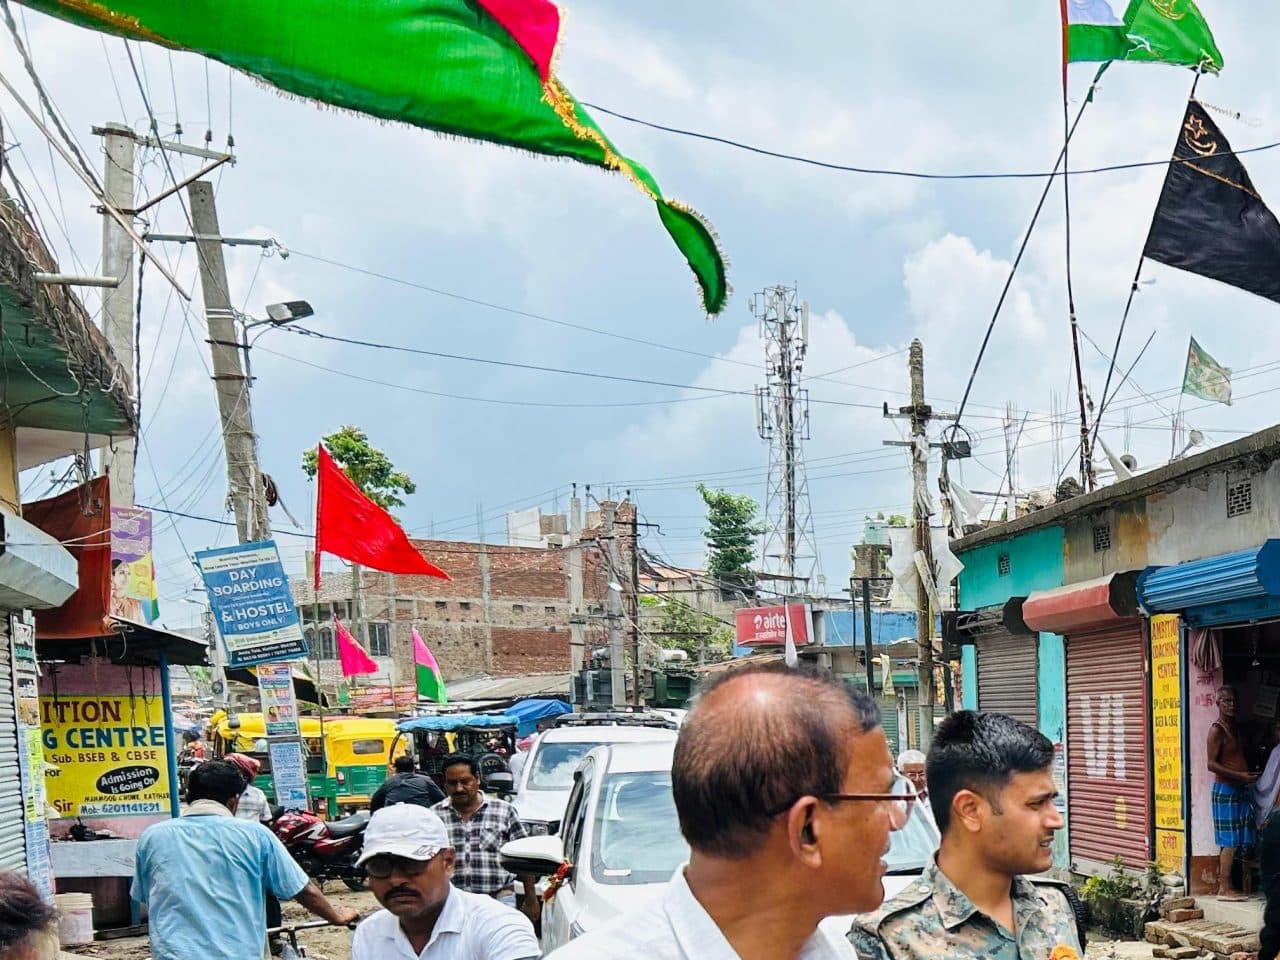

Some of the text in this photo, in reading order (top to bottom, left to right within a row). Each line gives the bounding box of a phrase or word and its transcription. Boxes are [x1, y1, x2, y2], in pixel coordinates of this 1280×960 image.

[229, 567, 257, 581] DAY
[213, 577, 283, 597] BOARDING
[222, 611, 234, 622] &
[236, 601, 292, 620] HOSTEL
[763, 612, 785, 629] airte
[41, 701, 122, 723] ITION
[42, 726, 165, 749] G CENTRE
[52, 750, 157, 763] Sub. BSEB & CBSE
[101, 768, 153, 786] Admission
[111, 777, 155, 794] Is Going On
[53, 799, 74, 813] Sir
[102, 802, 160, 813] 6201141291
